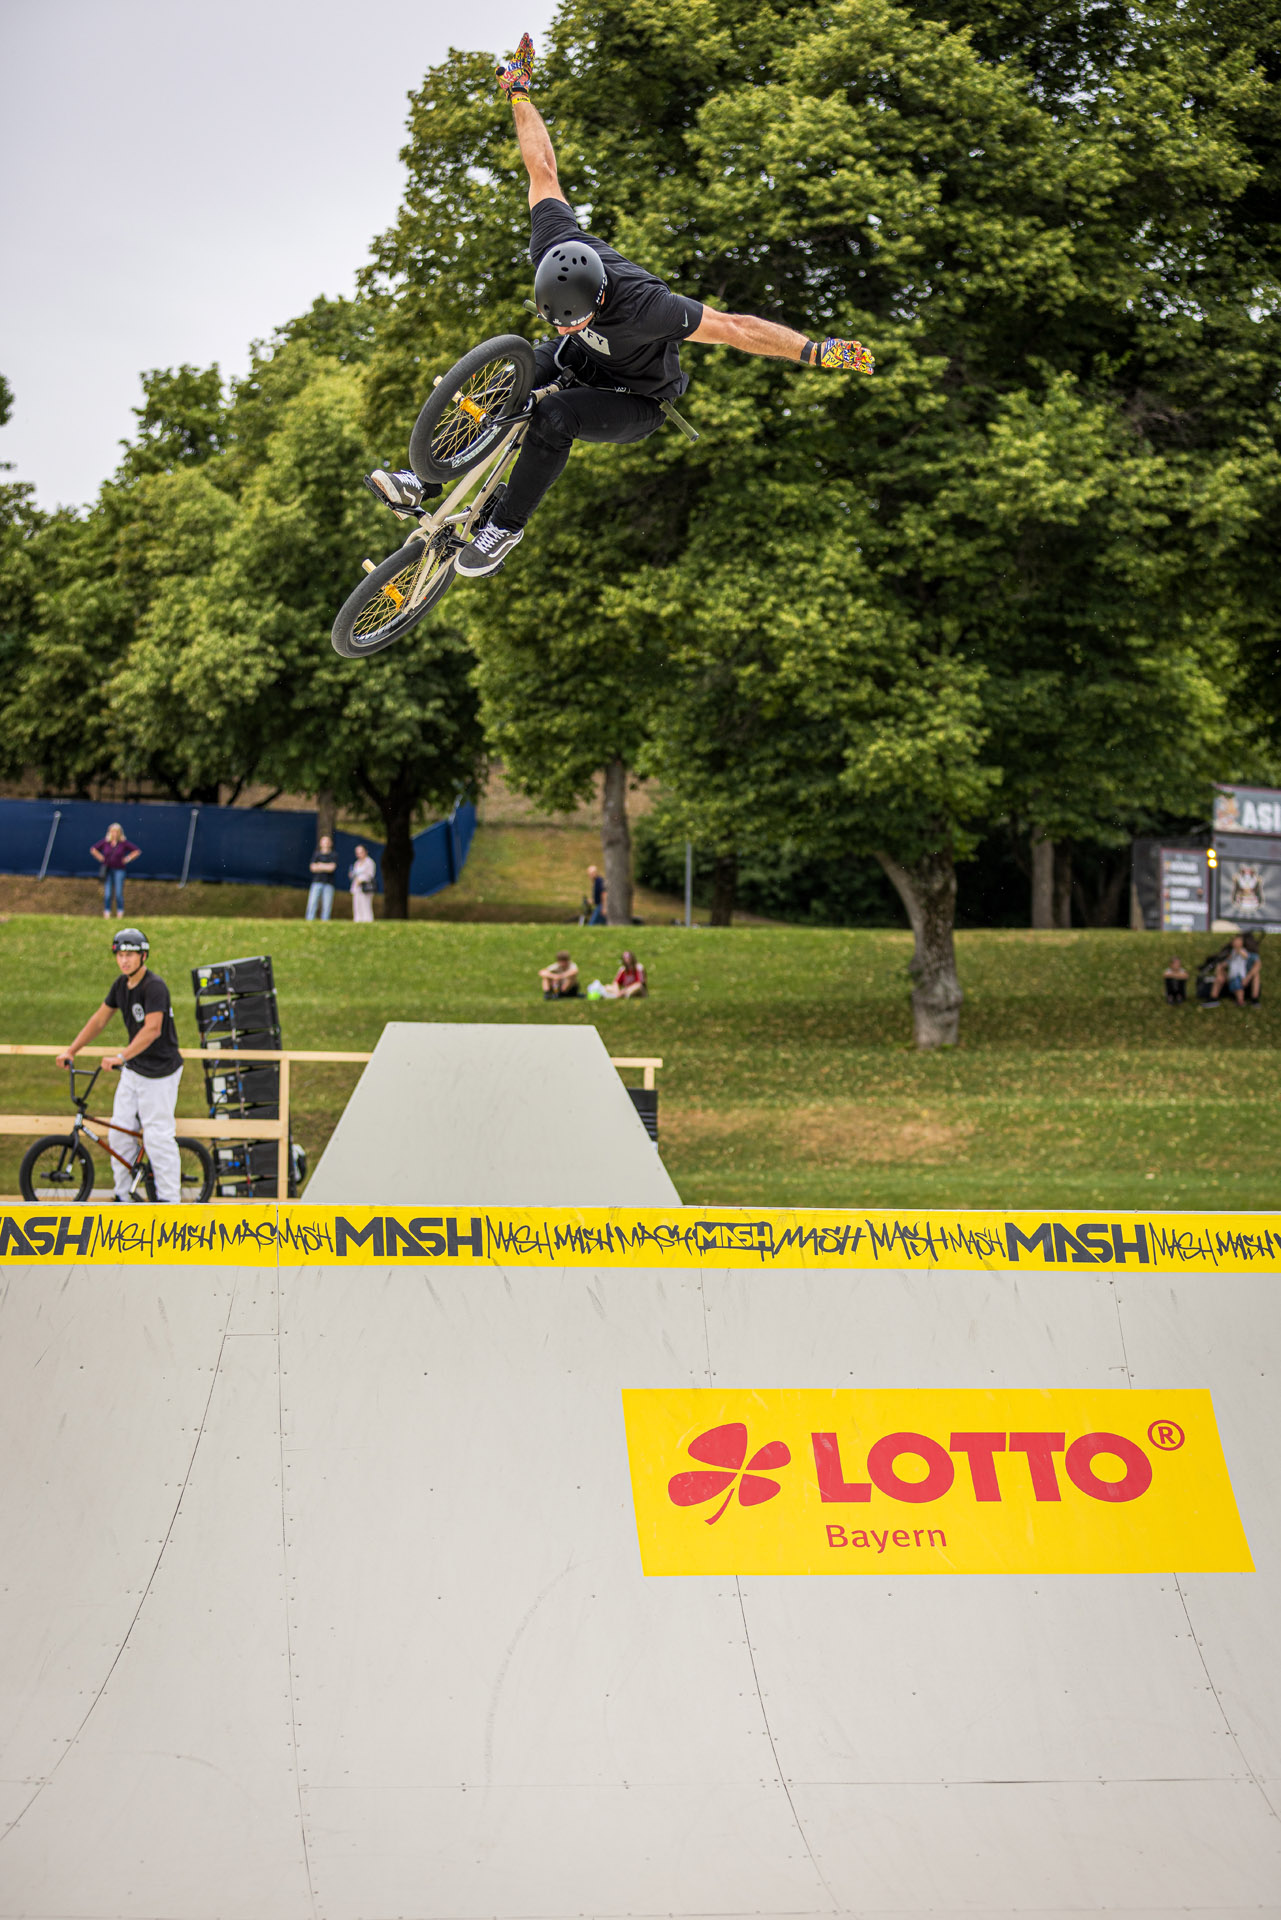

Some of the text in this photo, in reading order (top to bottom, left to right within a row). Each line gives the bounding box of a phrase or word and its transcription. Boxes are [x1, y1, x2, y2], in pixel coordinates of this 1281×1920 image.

[0, 1216, 94, 1256] ASH
[90, 1214, 155, 1258] MASH
[157, 1219, 216, 1252] MASH
[218, 1219, 278, 1253] MAS
[335, 1216, 483, 1257] MASH
[486, 1215, 555, 1260] MASH
[554, 1222, 614, 1254] MASH
[614, 1221, 694, 1256] MASH
[696, 1225, 771, 1248] MASH
[774, 1224, 867, 1256] MASH
[865, 1219, 949, 1262] MASH
[948, 1223, 1007, 1260] MASH
[1005, 1222, 1150, 1264] MASH
[1149, 1221, 1219, 1266] MASH
[1216, 1229, 1276, 1260] MASH
[811, 1431, 1154, 1504] LOTTO
[825, 1524, 948, 1554] Bayern
